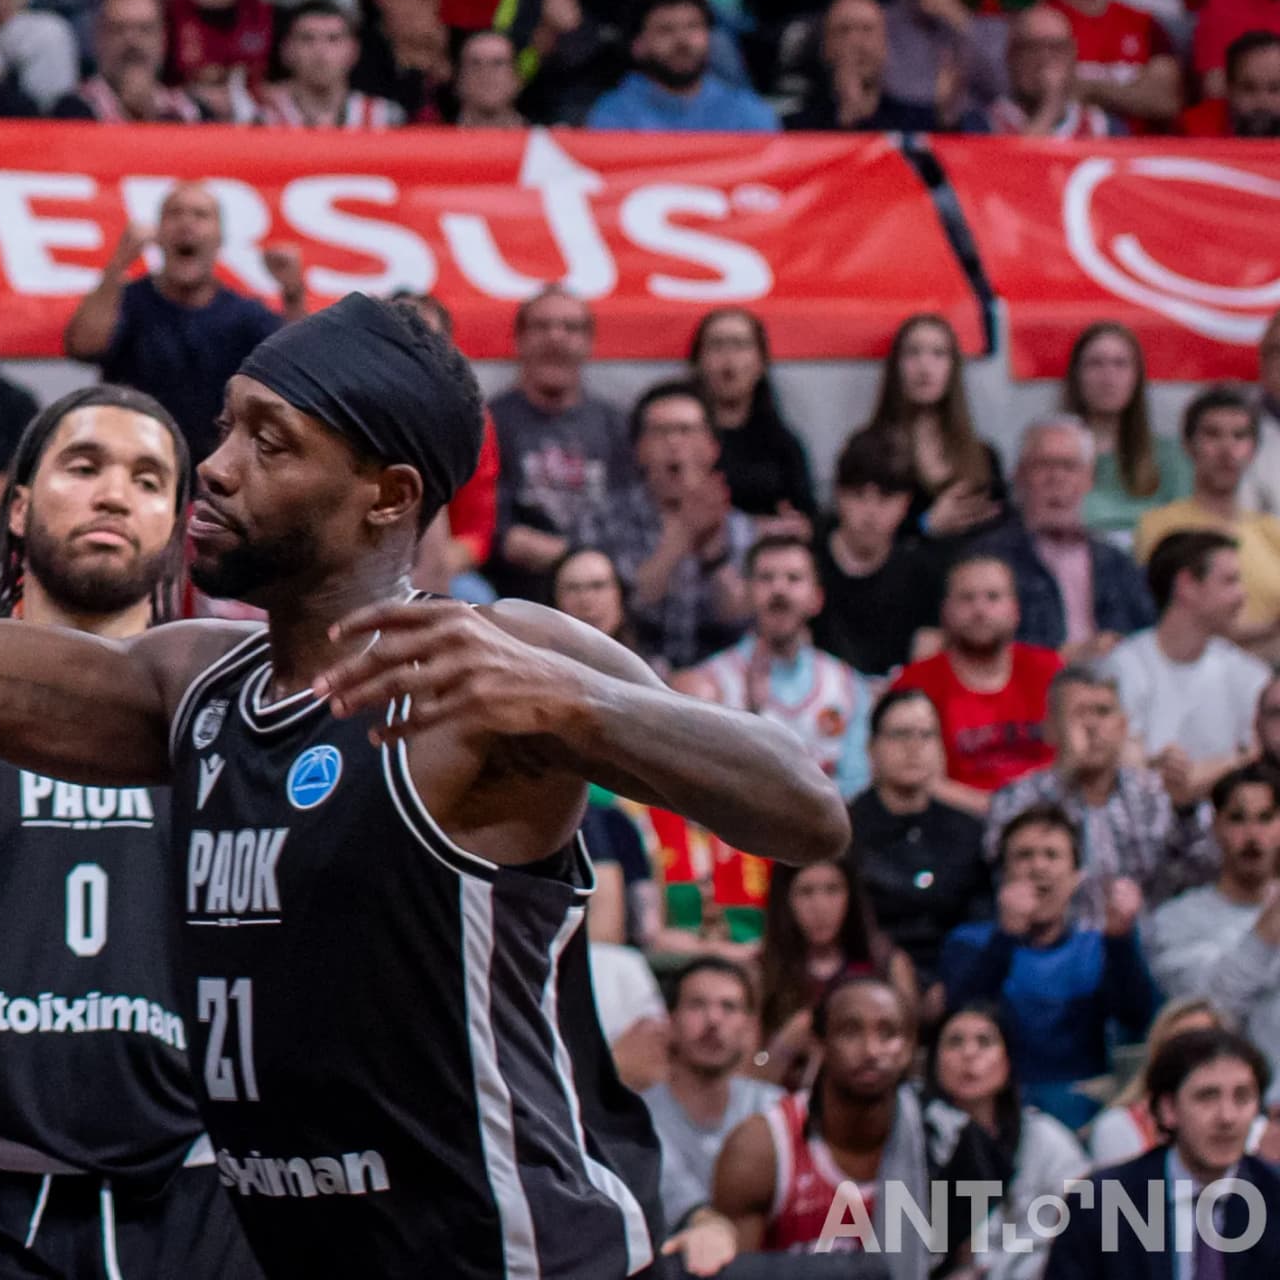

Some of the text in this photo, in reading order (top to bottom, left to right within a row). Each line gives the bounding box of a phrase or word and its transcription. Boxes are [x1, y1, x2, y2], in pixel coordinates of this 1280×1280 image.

[66, 863, 109, 957] 0
[186, 826, 290, 914] PAOK
[197, 976, 261, 1102] 21
